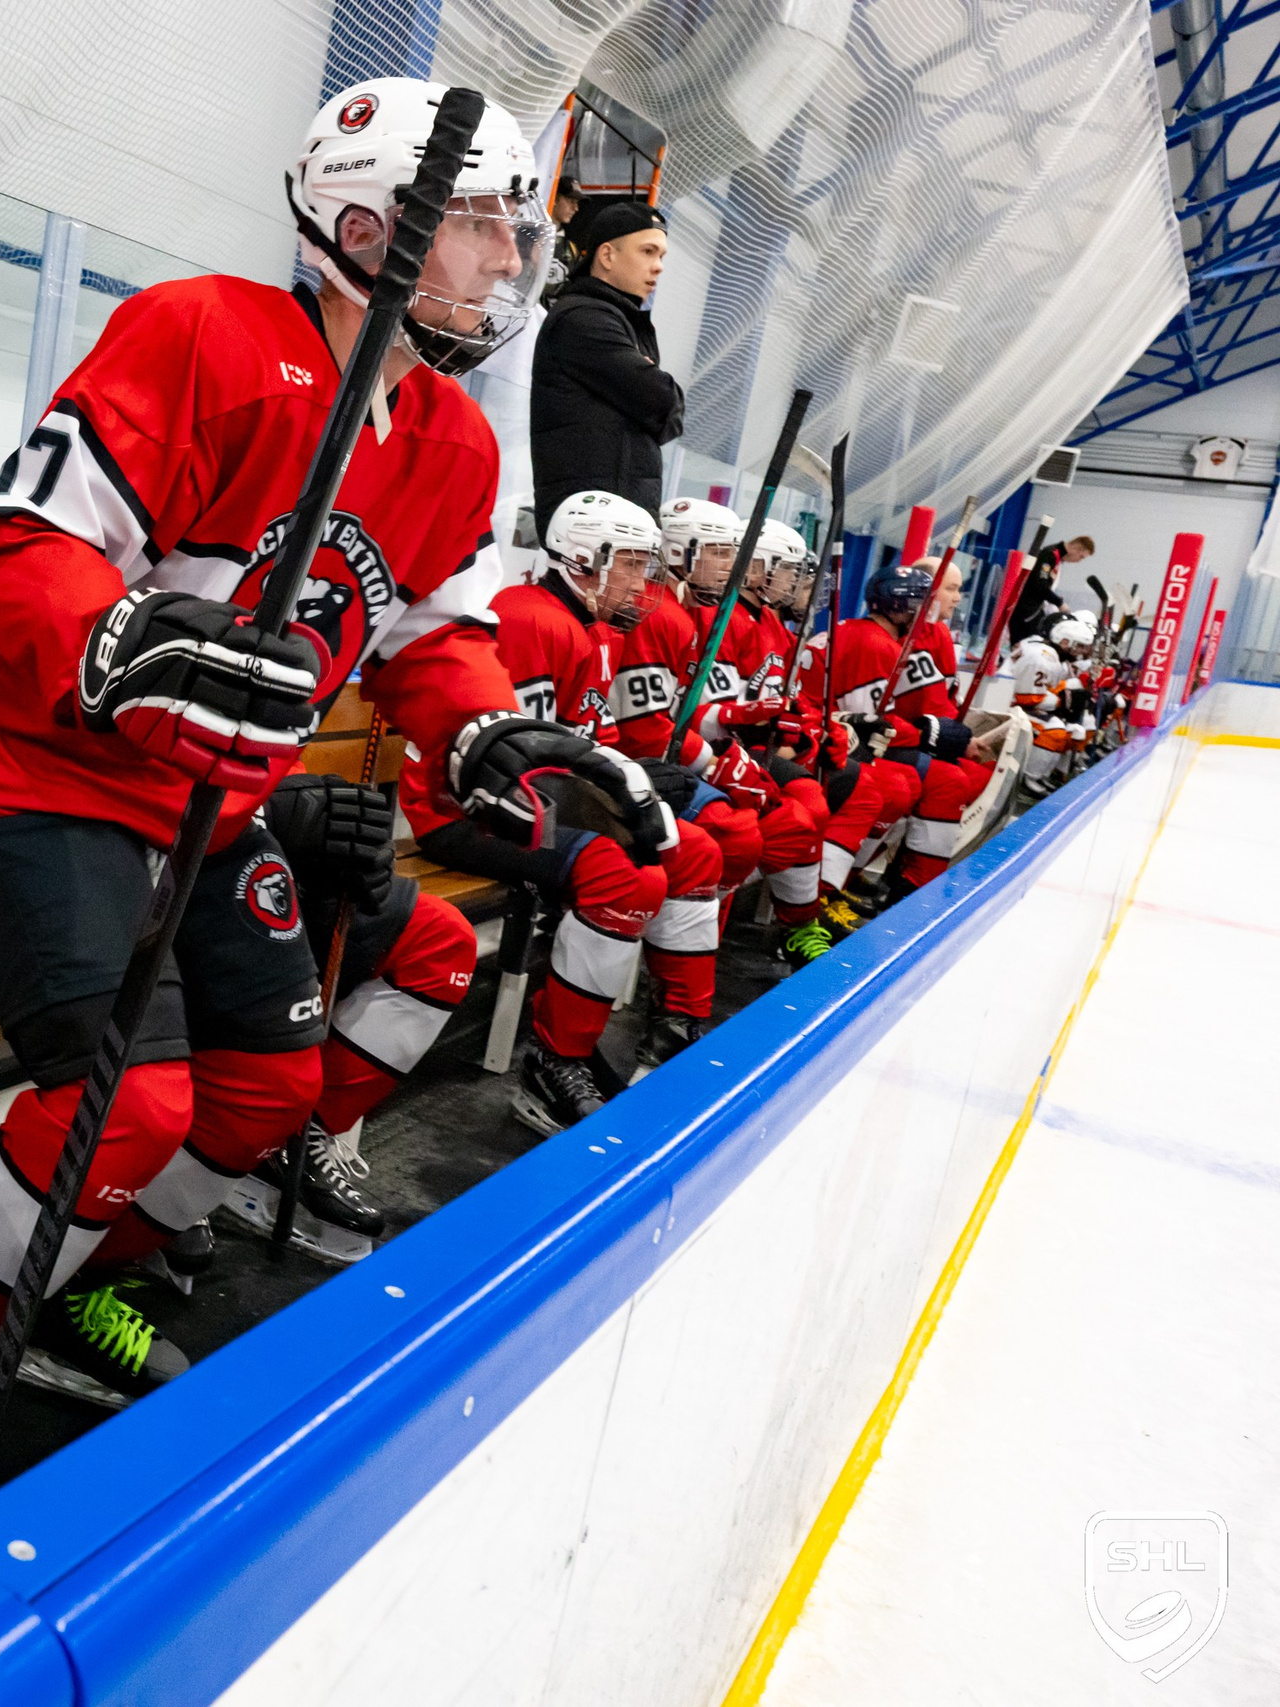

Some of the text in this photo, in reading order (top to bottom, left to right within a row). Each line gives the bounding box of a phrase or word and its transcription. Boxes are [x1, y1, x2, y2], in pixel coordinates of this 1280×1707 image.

[322, 158, 376, 175] BAUER
[1143, 563, 1191, 689] PROSTOR
[706, 666, 731, 694] 18
[906, 655, 935, 684] 20
[628, 673, 668, 708] 99
